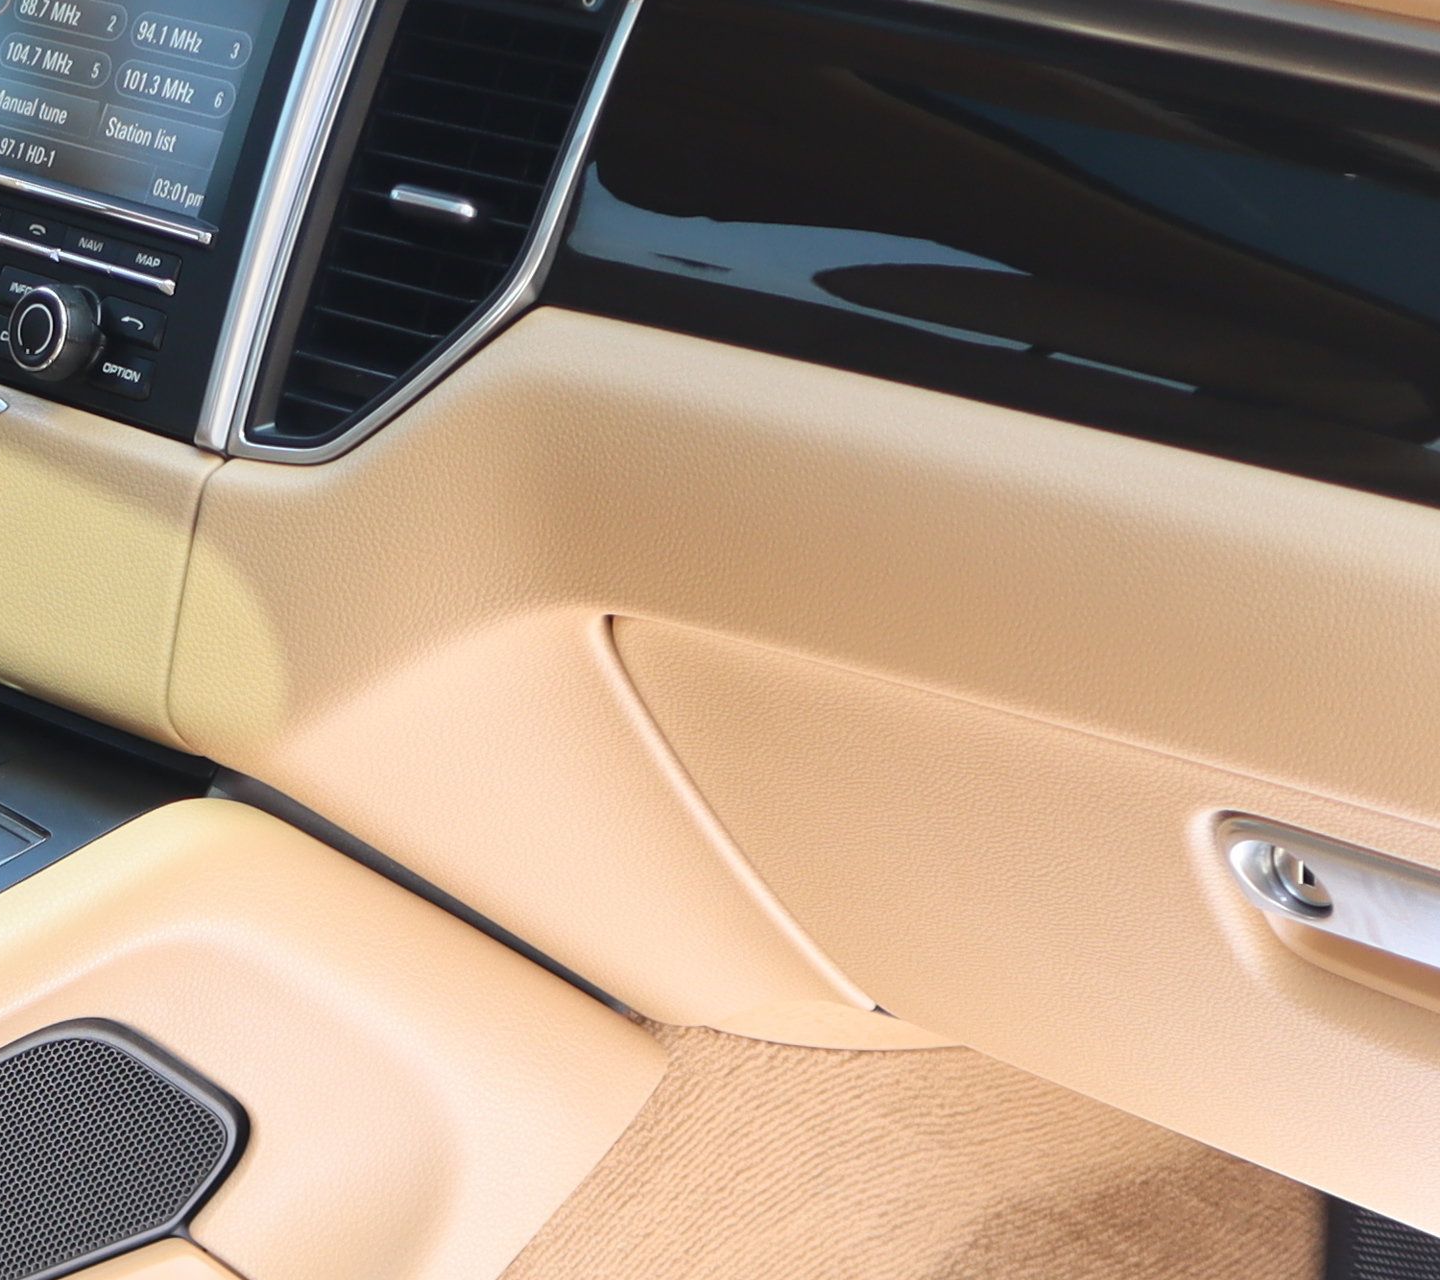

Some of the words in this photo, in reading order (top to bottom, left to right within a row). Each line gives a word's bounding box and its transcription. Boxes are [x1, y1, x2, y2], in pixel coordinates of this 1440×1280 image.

[50, 2, 81, 27] MHz
[106, 15, 117, 32] 2
[137, 21, 168, 45] 94.1
[169, 28, 203, 54] MHz
[6, 41, 41, 66] 104.7
[42, 50, 73, 75] MHz
[230, 43, 240, 59] 3
[91, 62, 101, 79] 5
[123, 69, 160, 95] 101.3
[161, 77, 195, 104] MHz
[214, 91, 224, 109] 6
[39, 102, 68, 125] tune
[106, 117, 152, 147] Station
[154, 129, 178, 153] list
[0, 138, 26, 160] 97.1
[26, 143, 56, 168] HD-1
[78, 237, 104, 253] NAVI
[135, 252, 162, 268] MAP
[102, 362, 141, 382] OPTION
